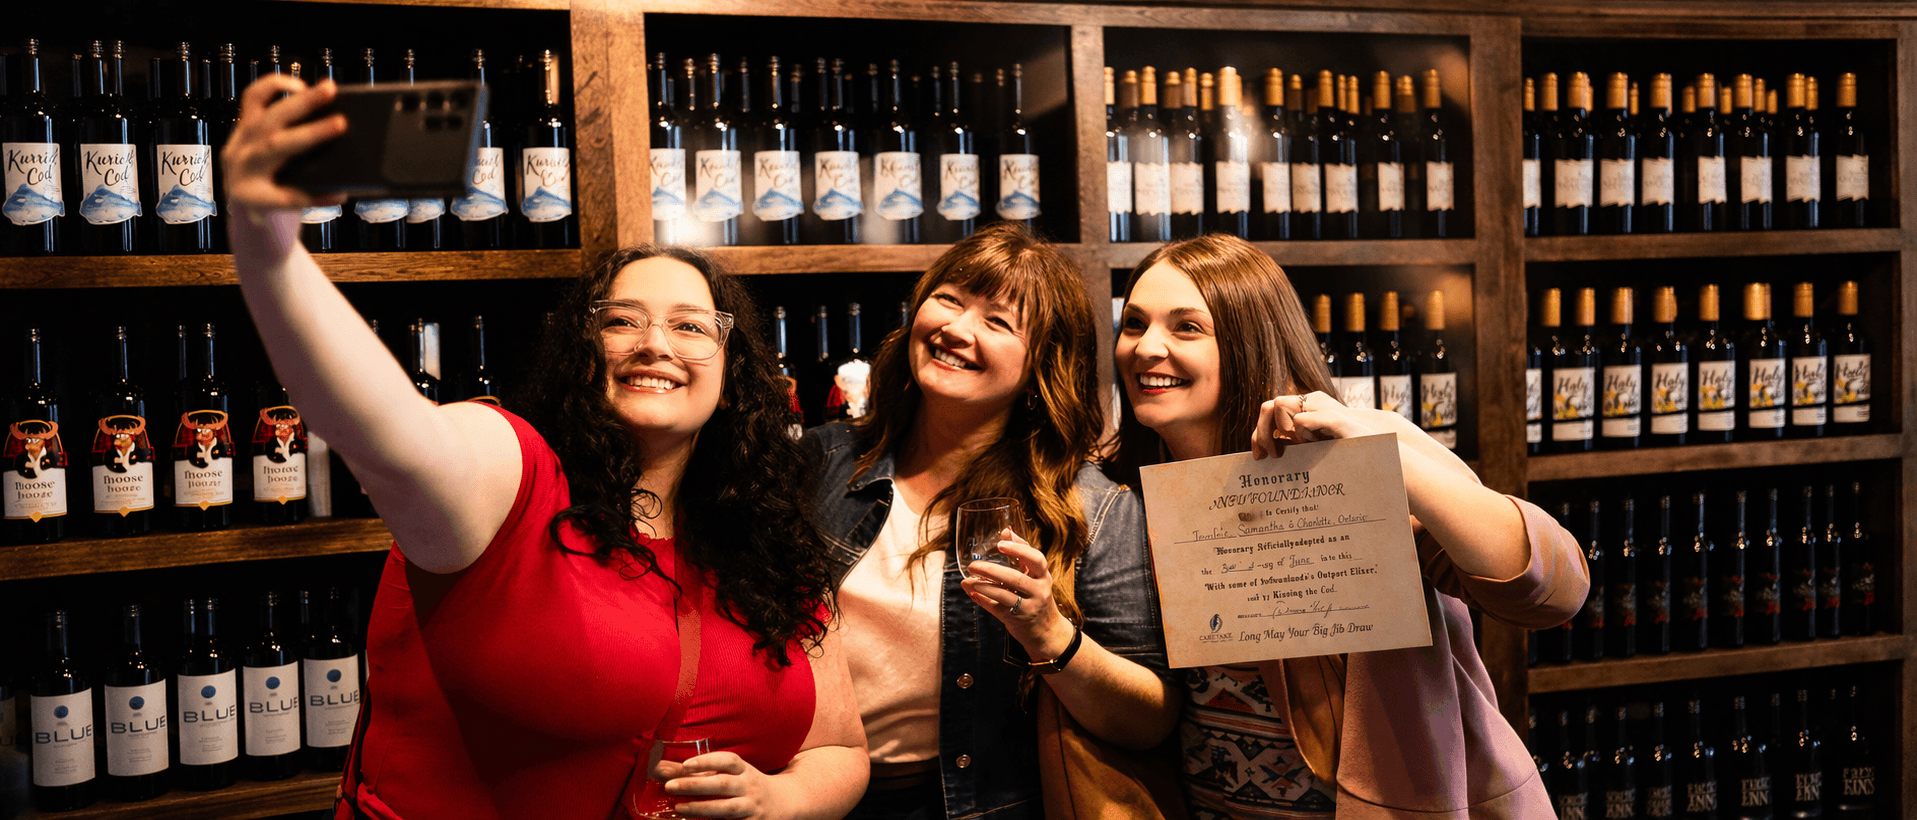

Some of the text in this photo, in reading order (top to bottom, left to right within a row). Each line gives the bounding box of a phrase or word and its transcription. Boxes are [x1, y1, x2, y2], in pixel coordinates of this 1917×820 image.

[27, 165, 52, 186] Cod
[104, 165, 129, 187] Cod
[1239, 471, 1310, 488] Honorary
[1239, 622, 1374, 644] Long May Your Big Jib Draw
[249, 697, 298, 713] BLUE
[310, 690, 361, 706] BLUE
[183, 705, 235, 723] BLUE
[35, 724, 92, 744] BLUE
[111, 715, 166, 734] BLUE
